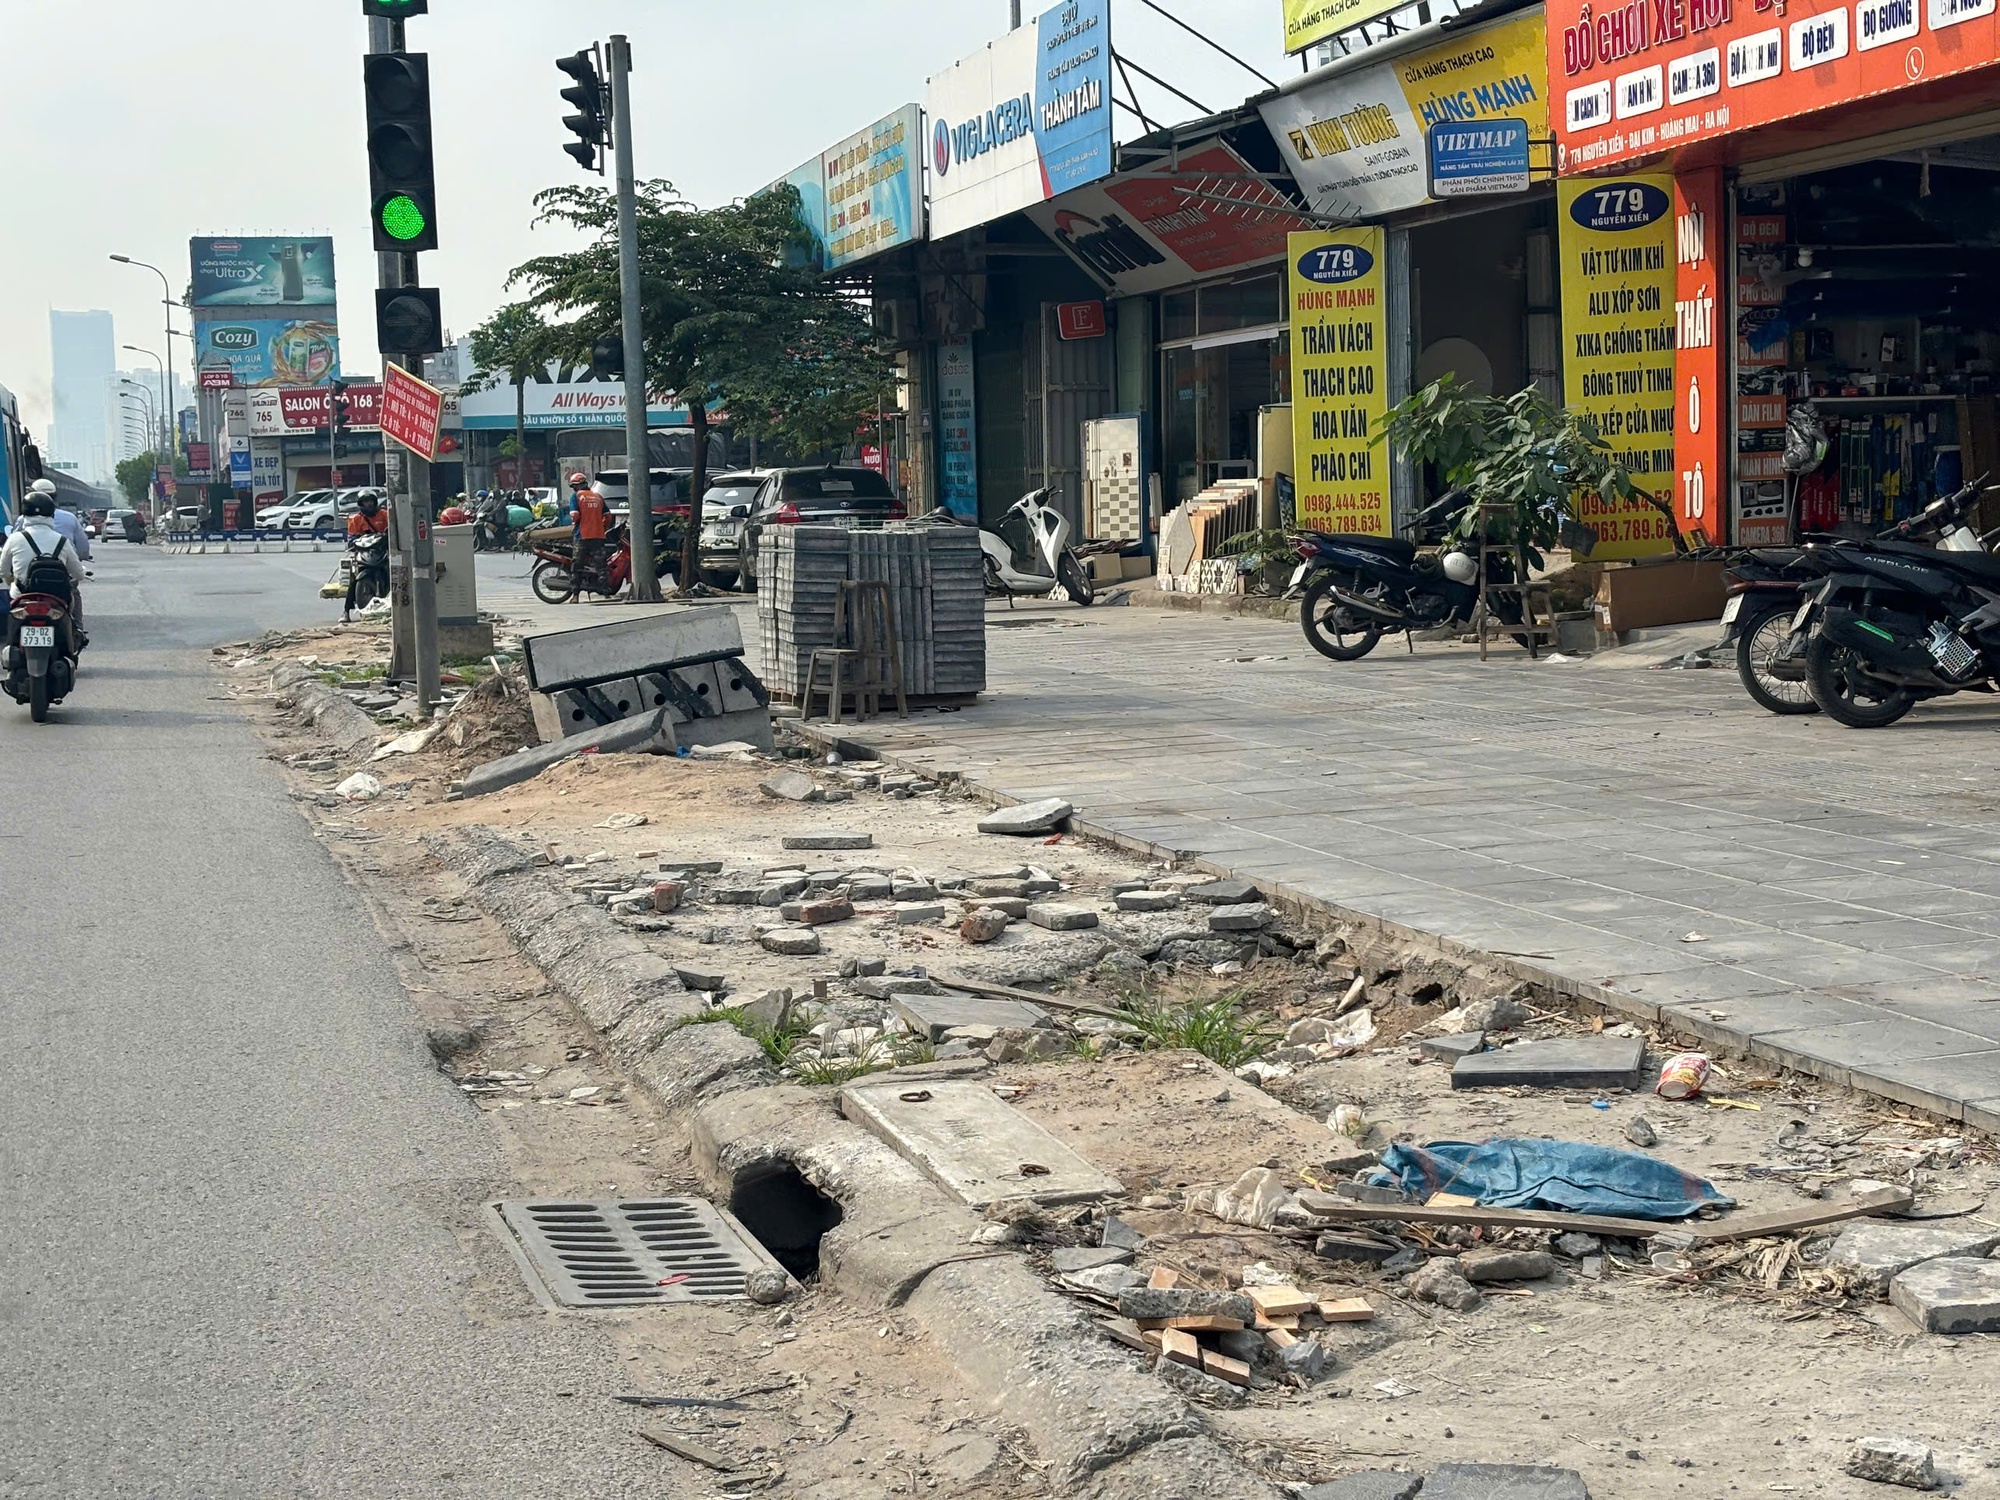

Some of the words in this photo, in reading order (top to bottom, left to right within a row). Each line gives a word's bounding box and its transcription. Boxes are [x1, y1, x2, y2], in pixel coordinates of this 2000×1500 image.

[1564, 3, 1593, 76] ĐỒ
[1802, 26, 1815, 60] ĐỘ
[1817, 21, 1835, 54] ĐÈN
[1423, 62, 1447, 80] HÀNG
[1446, 53, 1475, 71] THẠCH
[1475, 46, 1495, 63] CAO
[1673, 65, 1702, 96] CAMA
[1702, 61, 1716, 87] 360
[1731, 46, 1740, 79] ĐỘ
[1041, 87, 1077, 132] THÀNH
[1076, 76, 1102, 114] TÂM
[1418, 91, 1476, 126] HÙNG
[1472, 74, 1538, 116] MẠNH
[951, 92, 1034, 165] VIGLACERA
[1436, 129, 1517, 152] VIETMAP
[1570, 147, 1582, 165] 779
[1641, 127, 1655, 146] KIM
[1660, 118, 1684, 141] HOÀNG
[1364, 147, 1411, 167] SAINT-GOBAIN
[861, 198, 870, 217] 3M
[1594, 188, 1644, 214] 779
[1677, 202, 1705, 270] NỘI
[1316, 249, 1354, 269] 779
[1581, 247, 1602, 281] VẬT
[1604, 248, 1622, 274] TƯ
[1622, 247, 1643, 273] KIM
[1645, 240, 1664, 270] KHÍ
[1297, 288, 1333, 310] HÙNG
[1336, 288, 1375, 311] MẠNH
[1589, 291, 1609, 316] ALU
[1612, 281, 1634, 314] XỐP
[1637, 285, 1660, 311] SƠN
[1675, 284, 1714, 350] THẤT
[215, 331, 253, 346] Cozy
[1301, 315, 1335, 355] TRẦN
[1338, 316, 1373, 353] VÁCH
[1576, 331, 1602, 358] XIKA
[1604, 322, 1642, 356] CHỐNG
[1644, 318, 1676, 353] THẤM
[1303, 366, 1345, 403] THẠCH
[1348, 365, 1374, 395] CAO
[1583, 369, 1613, 397] BÔNG
[1645, 367, 1672, 392] TINH
[229, 409, 245, 417] 765
[256, 411, 273, 422] 765
[285, 397, 320, 412] SALON
[353, 394, 374, 408] 168
[444, 401, 457, 411] 65
[552, 393, 575, 407] All
[576, 393, 616, 410] Ways
[1688, 375, 1700, 434] Ô
[1762, 403, 1782, 422] FILM
[540, 414, 565, 424] NHỜN
[567, 413, 578, 424] SỐ
[579, 414, 584, 423] 1
[586, 413, 602, 423] HÀN
[1312, 410, 1338, 440] HOA
[1341, 403, 1367, 438] VĂN
[1602, 404, 1623, 437] XẾP
[1626, 403, 1649, 434] CỬA
[1651, 405, 1676, 436] NHỰ
[254, 457, 264, 468] XE
[265, 457, 279, 471] ĐẸP
[1311, 447, 1346, 482] PHÀO
[1349, 441, 1371, 481] CHỈ
[1652, 448, 1676, 474] MIN
[1682, 460, 1704, 519] TÔ
[1741, 525, 1770, 546] CAMERA
[1771, 525, 1785, 545] 360
[23, 636, 53, 646] 373.19
